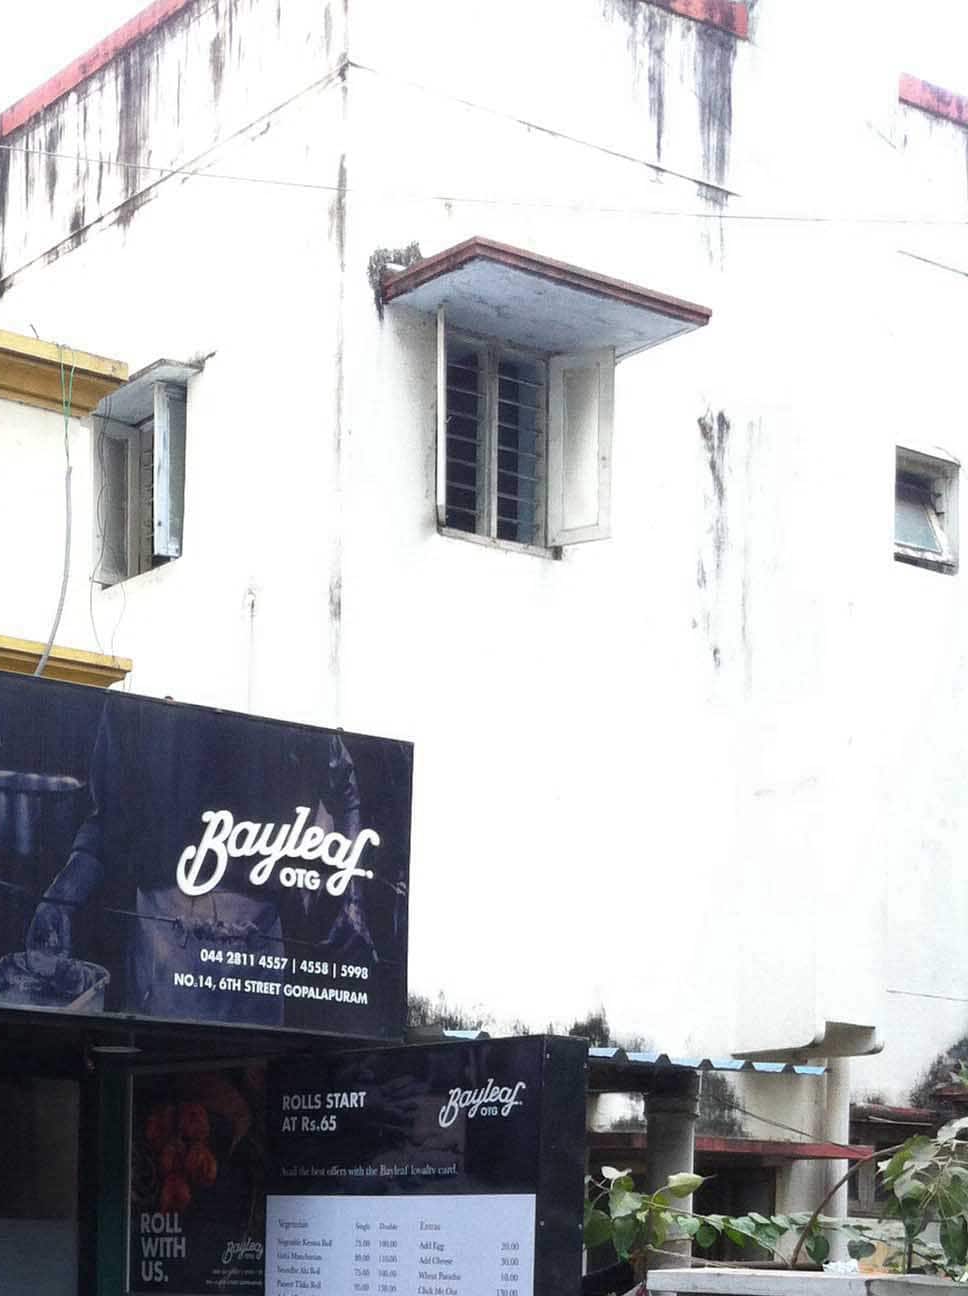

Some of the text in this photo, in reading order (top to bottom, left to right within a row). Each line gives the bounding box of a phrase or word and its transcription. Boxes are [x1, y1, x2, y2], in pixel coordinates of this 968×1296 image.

[177, 806, 380, 896] Bayleaf
[280, 867, 321, 891] OTG
[200, 949, 223, 964] 044
[226, 952, 254, 967] 2811
[258, 955, 288, 970] 4557
[300, 960, 329, 975] 4558
[340, 964, 368, 979] 5998
[219, 977, 241, 992] 6TH
[244, 980, 281, 996] STREET
[283, 984, 368, 1005] GOPALAPURAM
[282, 1091, 367, 1111] ROLLS START
[438, 1078, 526, 1128] Bayleaf
[282, 1114, 337, 1132] AT Rs.65
[140, 1212, 182, 1233] ROLL
[141, 1237, 186, 1258] WITH
[141, 1260, 169, 1282] US.
